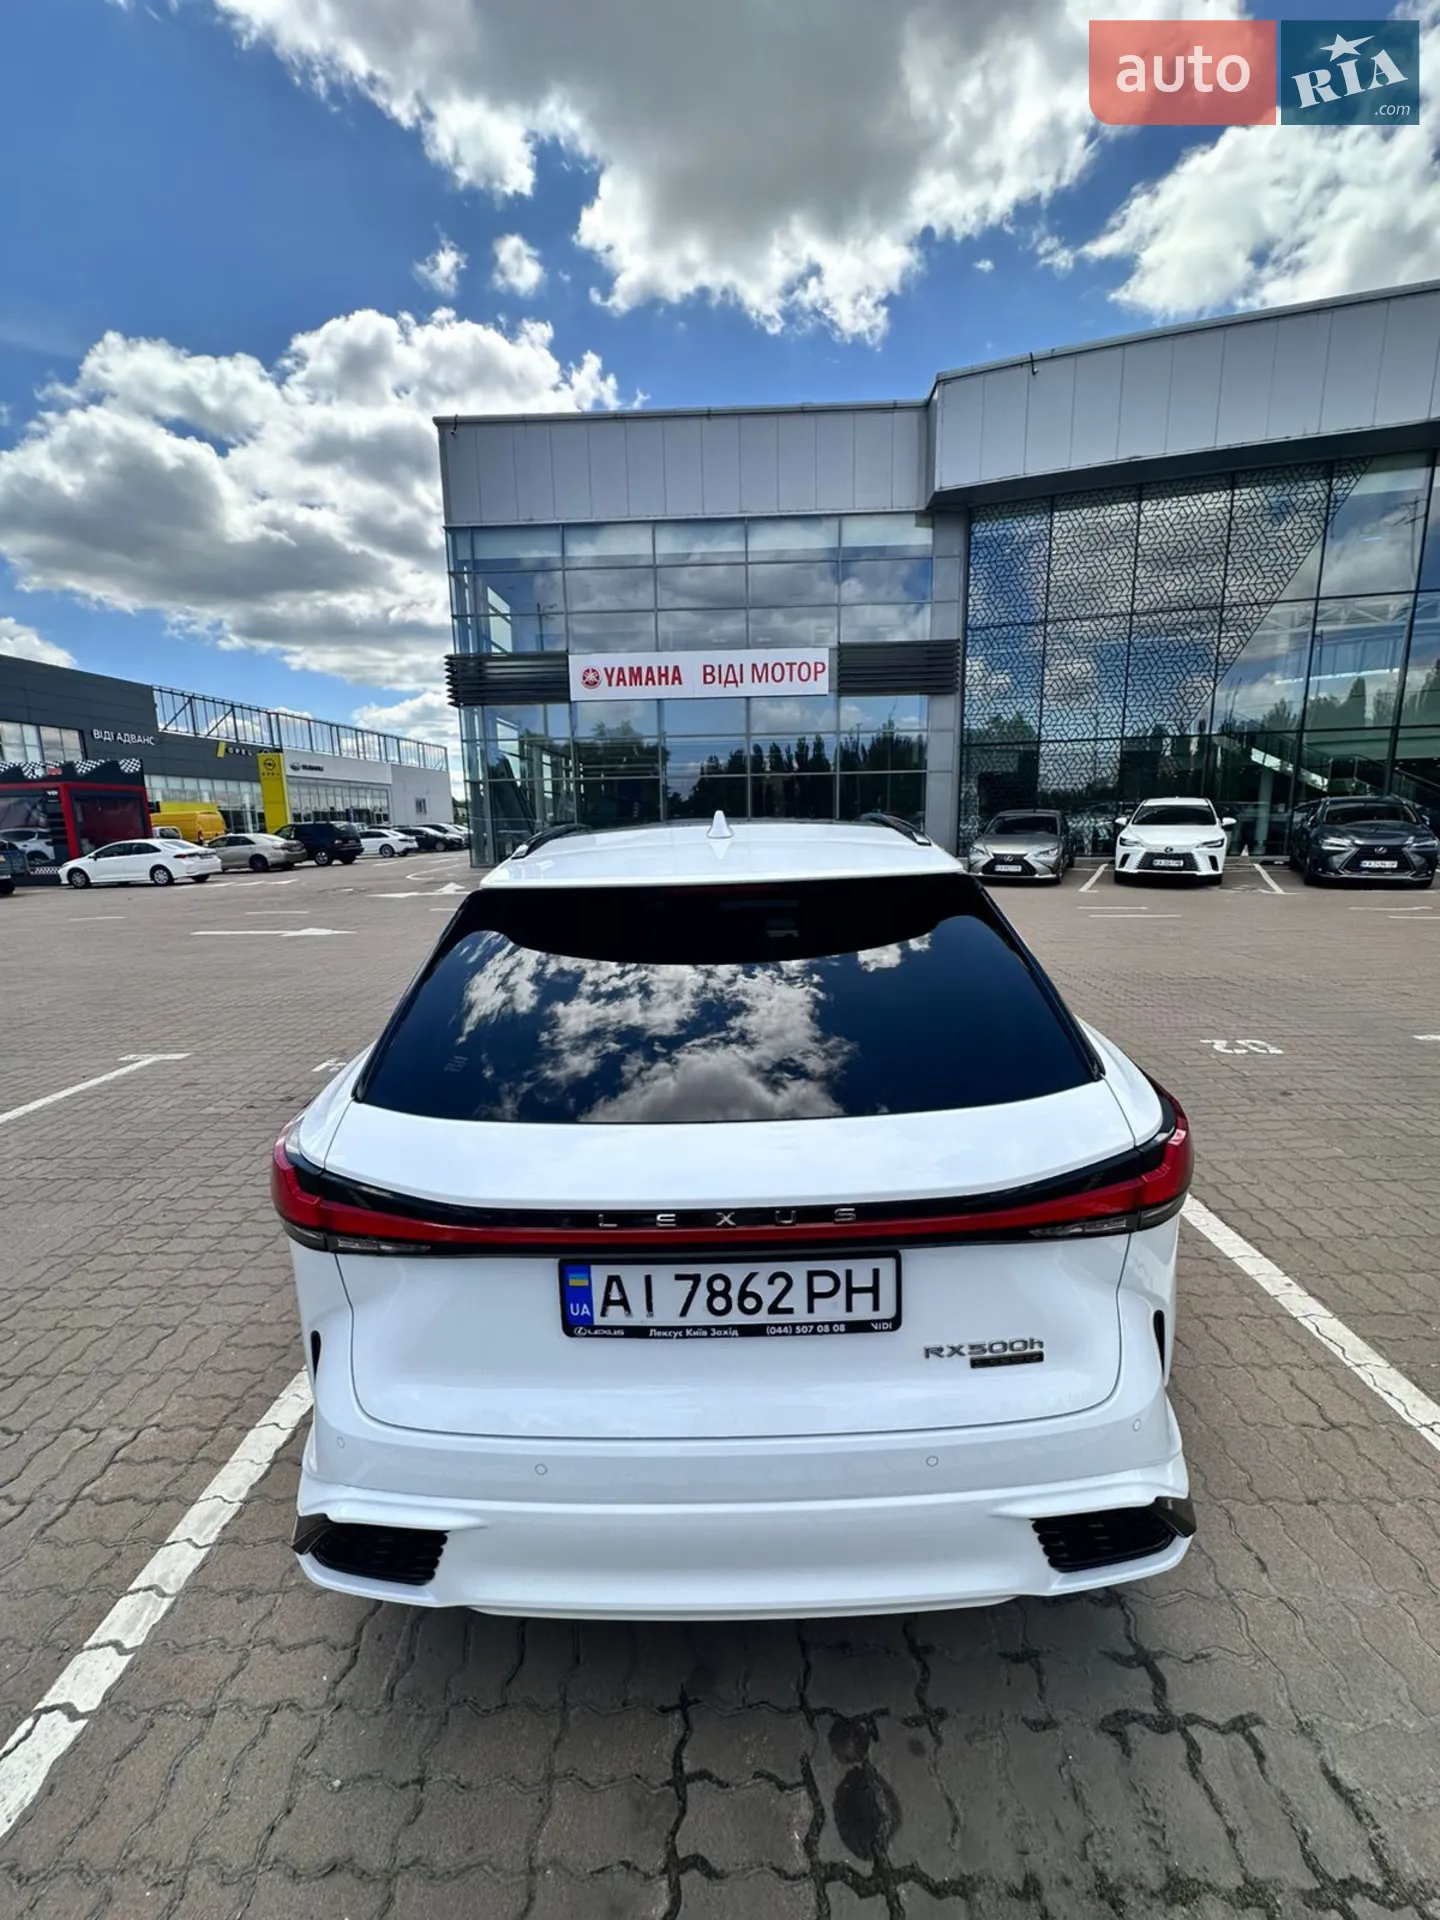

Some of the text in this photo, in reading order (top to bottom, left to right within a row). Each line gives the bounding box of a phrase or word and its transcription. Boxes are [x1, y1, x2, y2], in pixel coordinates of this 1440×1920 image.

[603, 665, 683, 687] YAMAHA
[702, 661, 826, 688] ВІДІ МОТОР
[93, 728, 156, 746] ВІДІ АДВАНС
[598, 1207, 855, 1228] LEXUS
[674, 1270, 795, 1317] 7862
[570, 1303, 591, 1316] UA
[588, 1327, 625, 1336] LEXUS
[766, 1323, 846, 1336] (044) 507 08 08
[870, 1322, 893, 1331] VIDI
[924, 1337, 1044, 1359] RX500h
